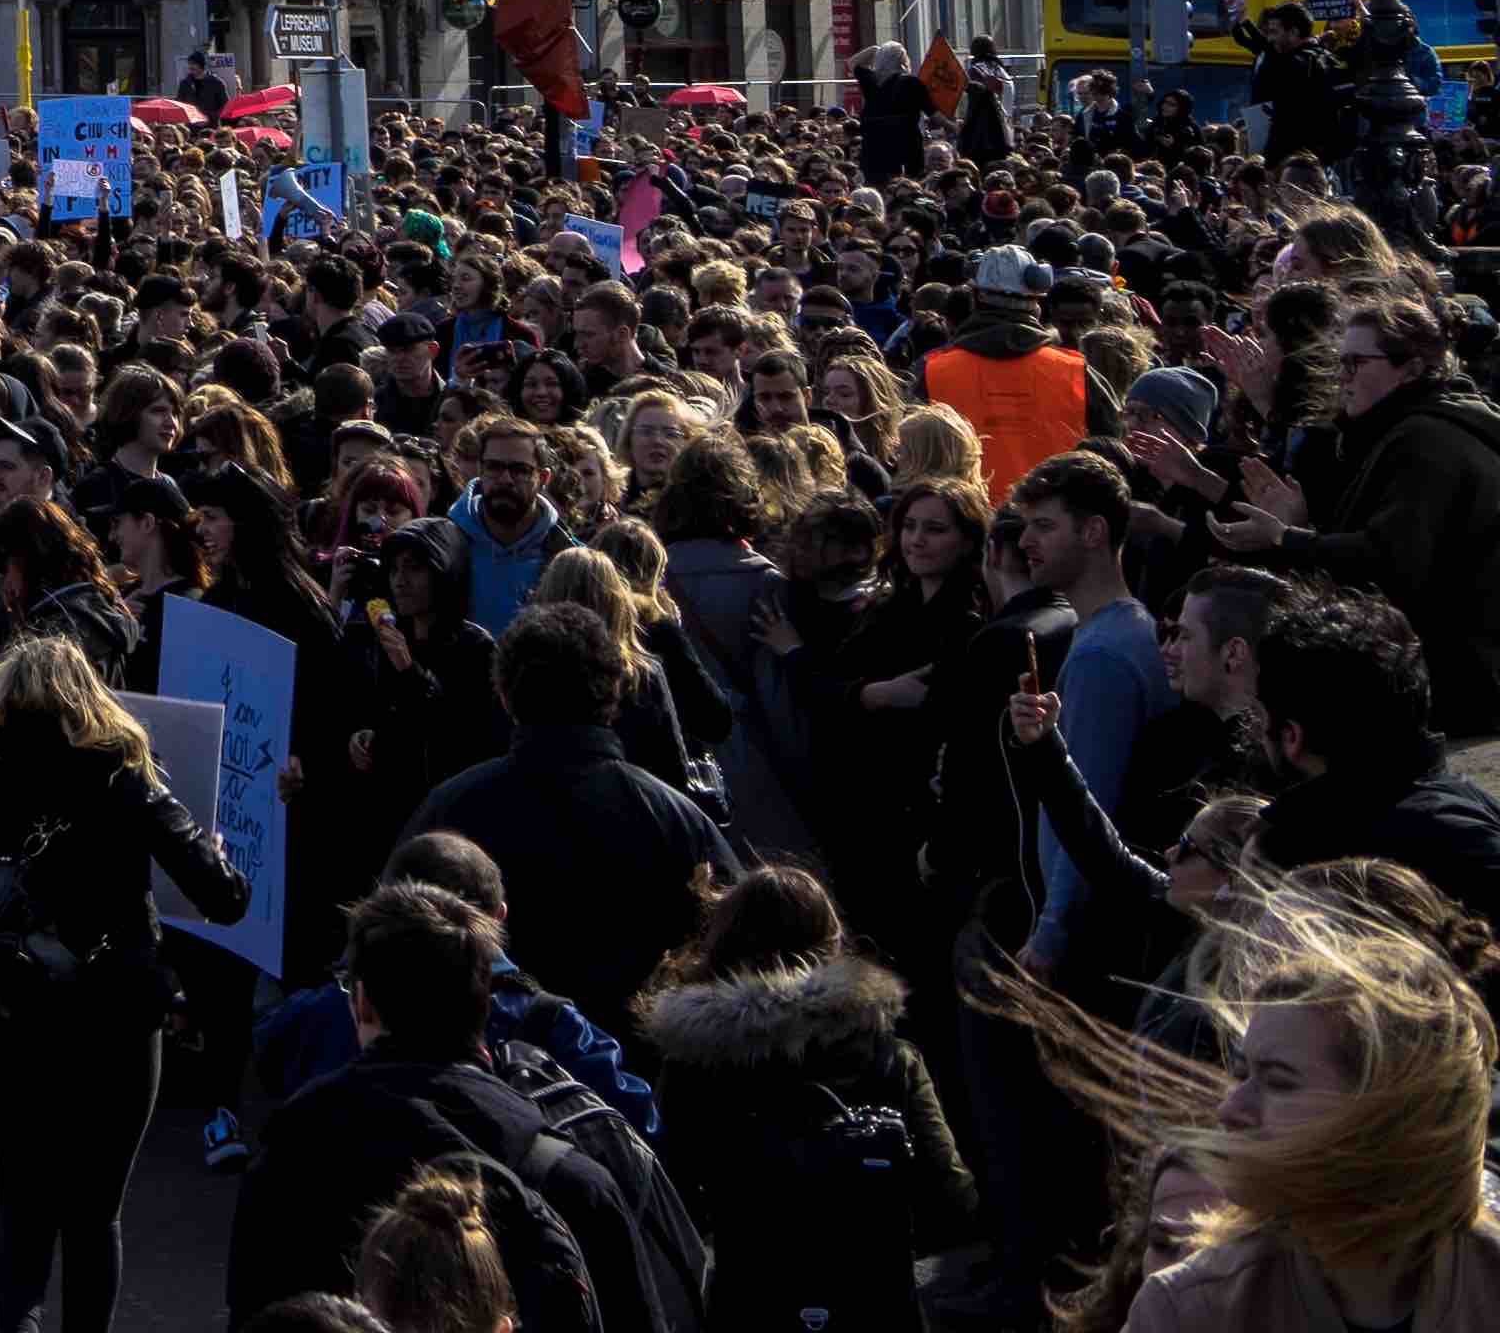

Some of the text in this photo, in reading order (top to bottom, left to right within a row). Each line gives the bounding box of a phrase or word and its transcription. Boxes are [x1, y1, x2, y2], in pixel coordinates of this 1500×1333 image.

[281, 13, 329, 33] LEPRECHAUN
[290, 35, 324, 52] MUSEUM
[43, 148, 60, 163] IN
